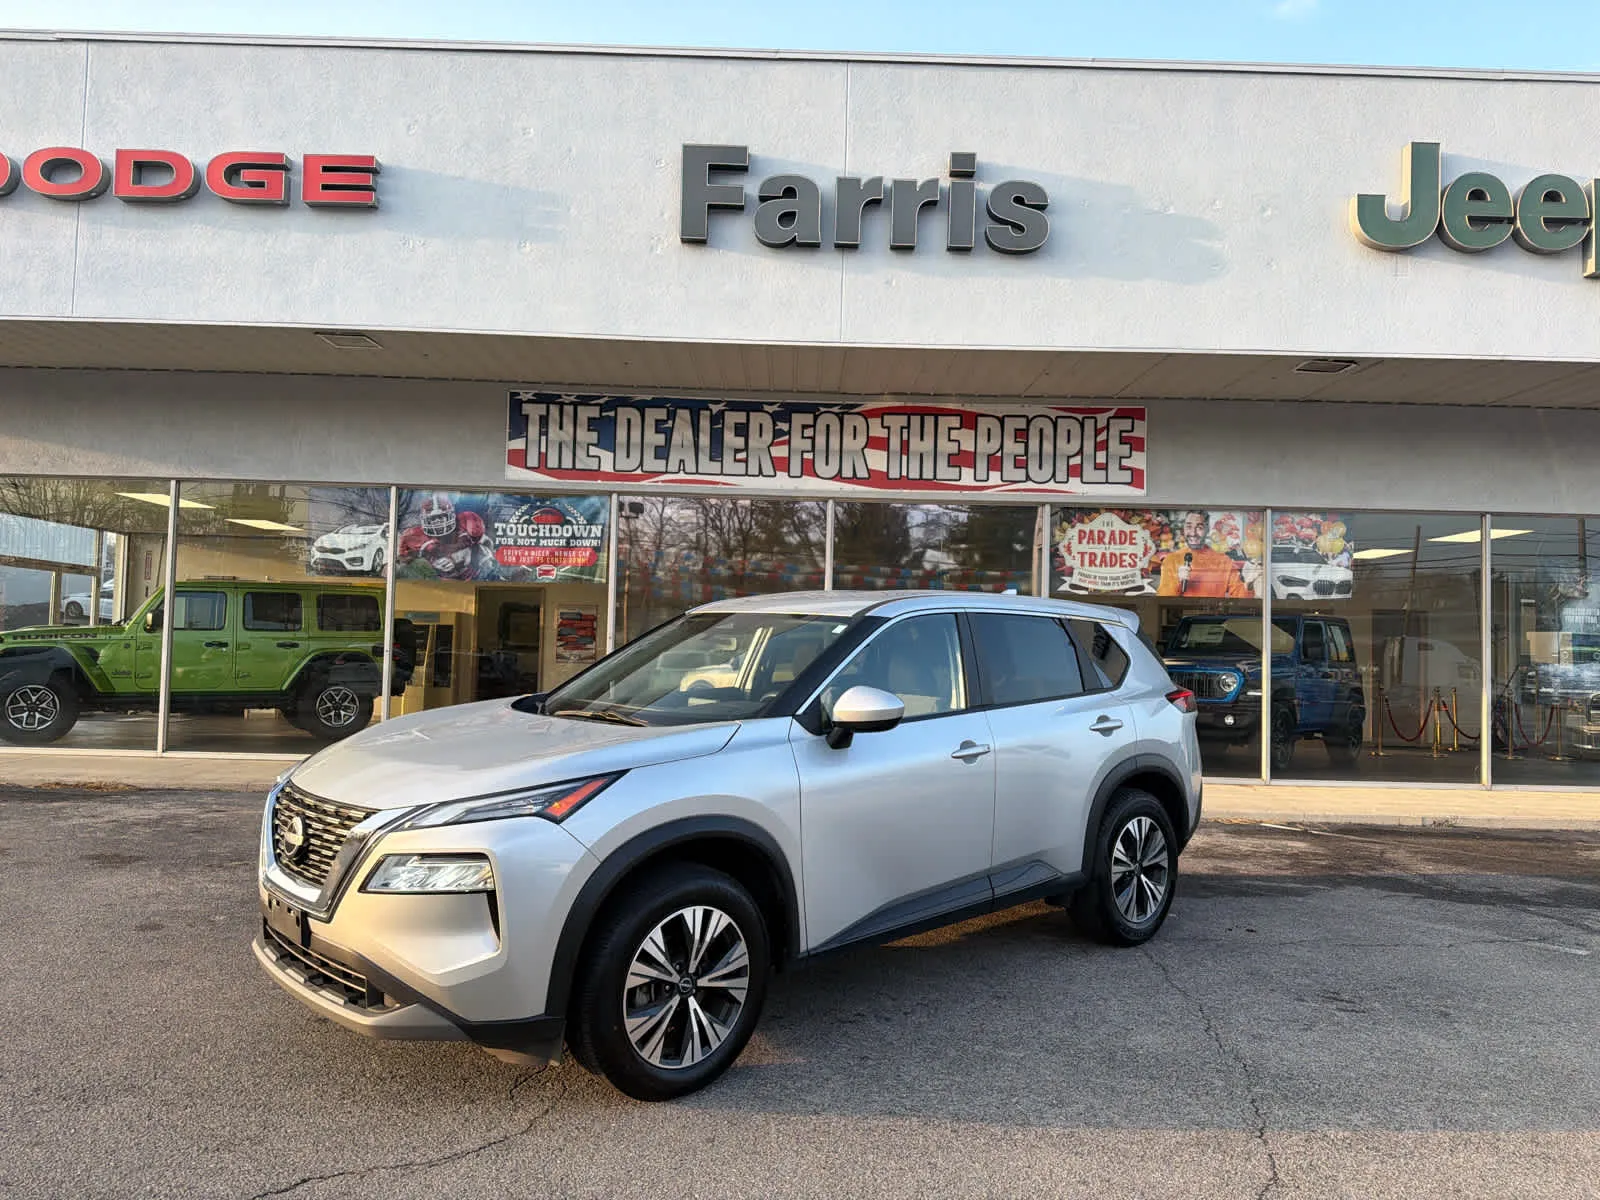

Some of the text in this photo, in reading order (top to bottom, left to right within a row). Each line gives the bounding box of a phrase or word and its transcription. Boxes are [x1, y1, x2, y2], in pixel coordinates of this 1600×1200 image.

[0, 146, 380, 209] ODGE
[680, 143, 1050, 254] Farris
[1350, 141, 1600, 278] Jee
[521, 402, 1134, 485] THE DEALER FOR THE PEOPLE
[494, 523, 602, 537] TOUCHDOWN
[495, 537, 514, 545] FOR
[517, 538, 536, 546] NOT
[540, 538, 567, 547] MUCH
[1077, 529, 1138, 545] PARADE
[1077, 551, 1138, 568] TRADES
